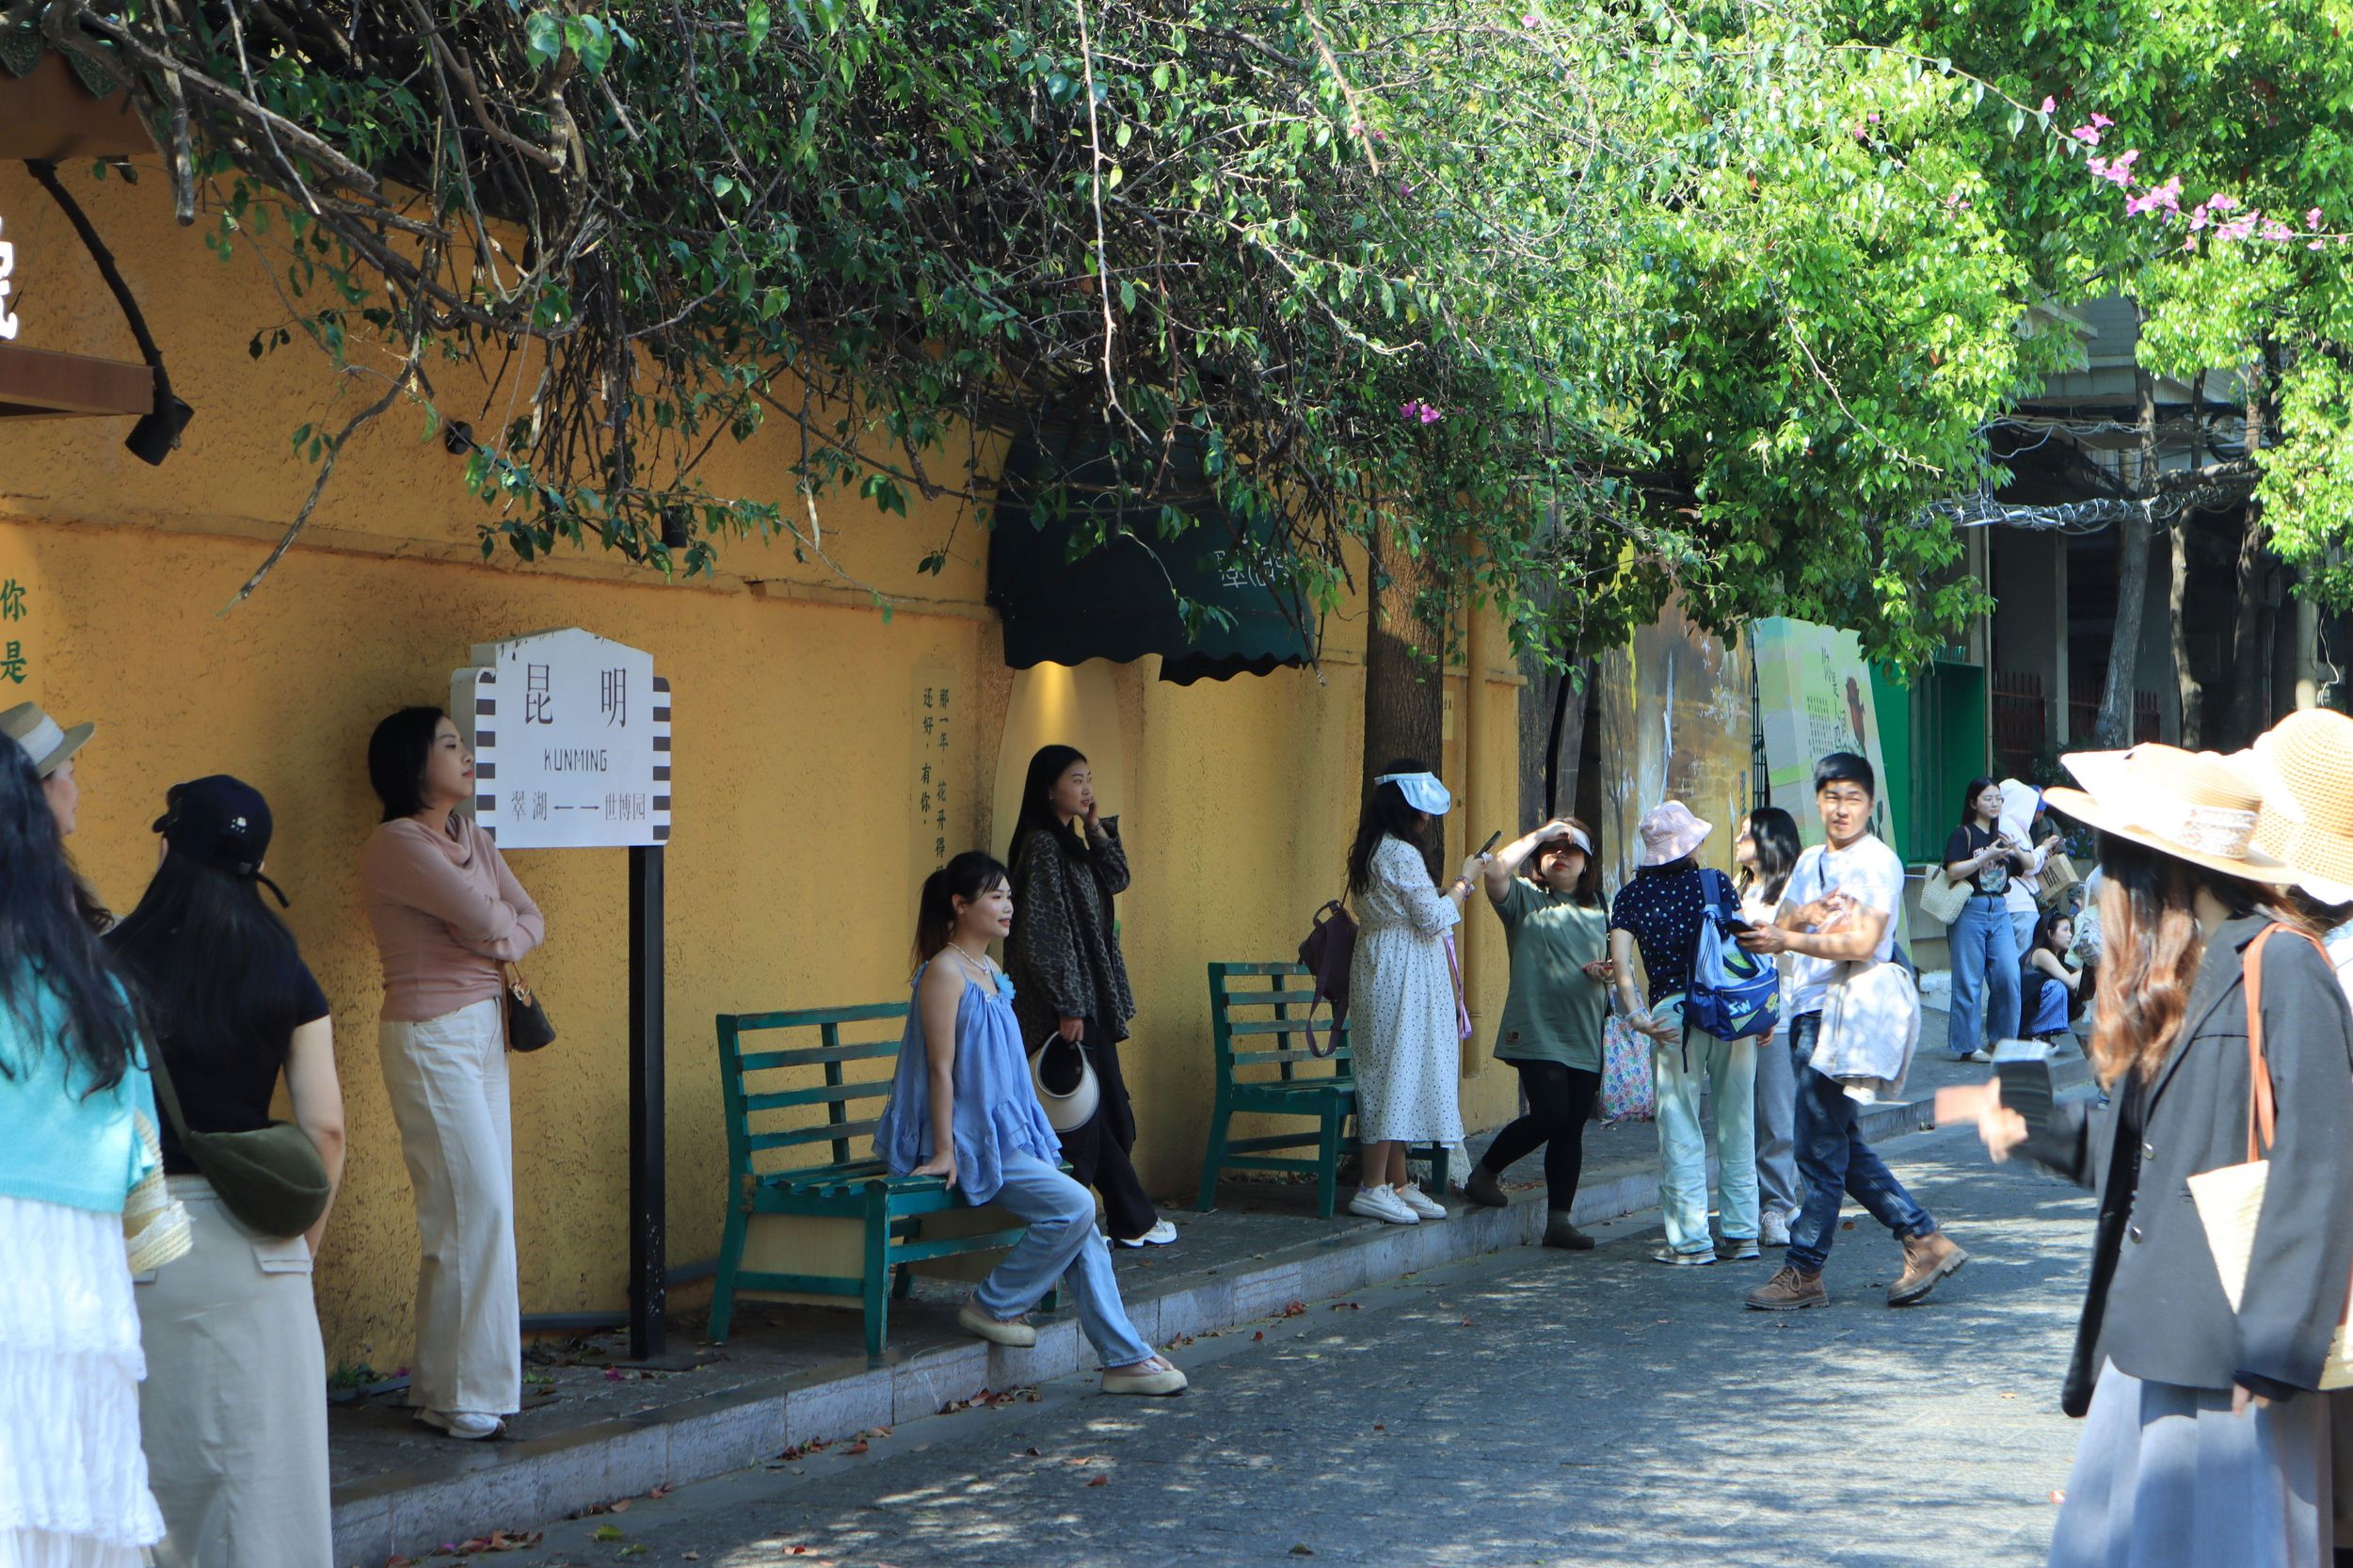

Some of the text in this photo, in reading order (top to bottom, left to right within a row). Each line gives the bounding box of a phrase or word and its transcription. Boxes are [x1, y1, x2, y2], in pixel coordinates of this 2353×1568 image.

[524, 662, 627, 728] 昆明
[544, 748, 608, 773] KUNMING
[511, 790, 646, 822] 翠湖 世博园
